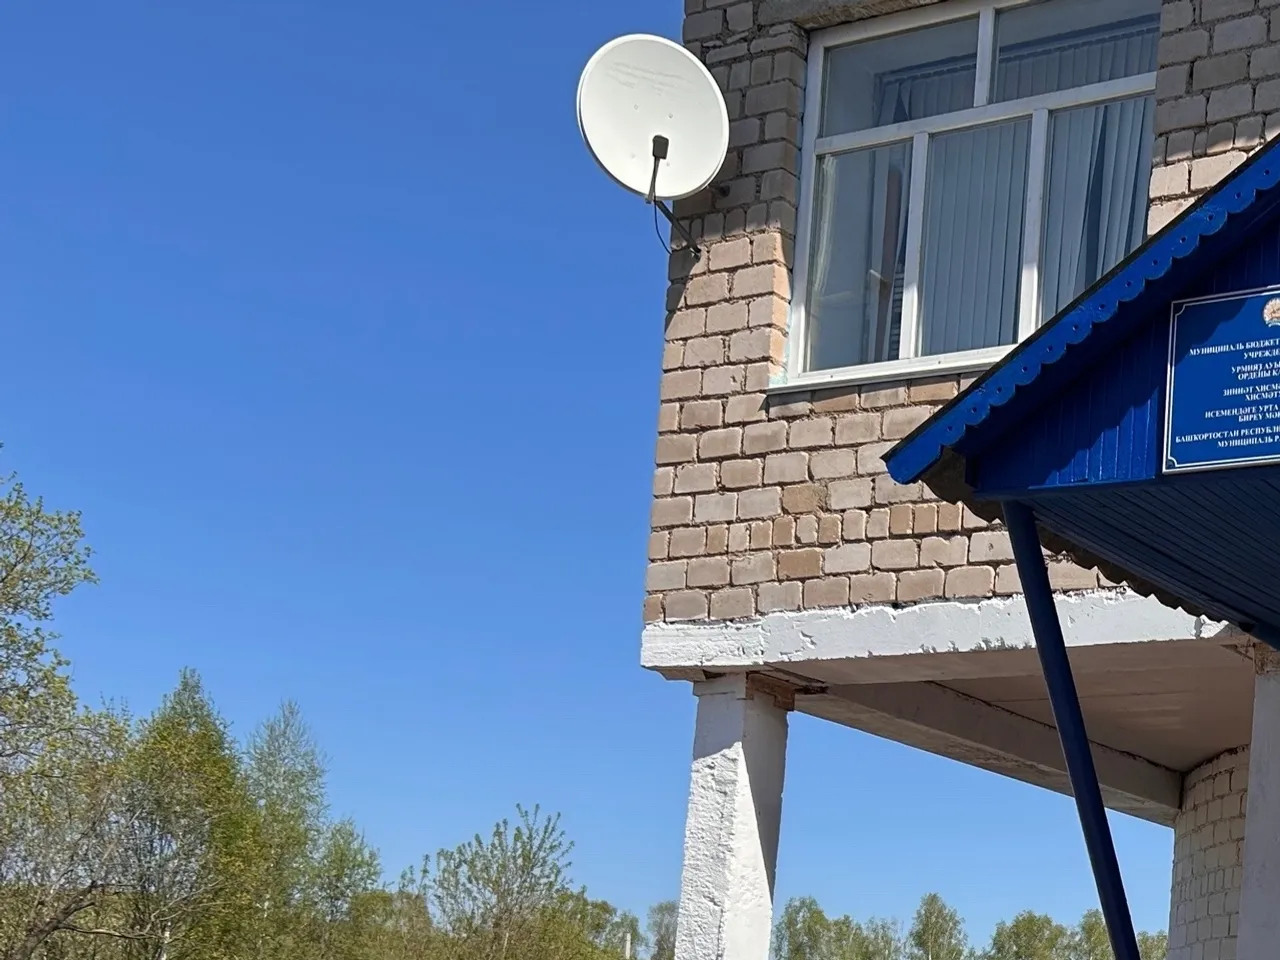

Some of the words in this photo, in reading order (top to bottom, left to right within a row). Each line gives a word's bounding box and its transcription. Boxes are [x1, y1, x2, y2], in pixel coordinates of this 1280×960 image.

[1190, 342, 1244, 356] МУНИЦИПАЛЬ
[1246, 337, 1280, 349] БЮДЖЕТ
[1238, 369, 1270, 380] ОРДЕНЫ
[1258, 403, 1280, 414] УРТА
[1217, 434, 1273, 448] МУНИЦИПАЛЬ
